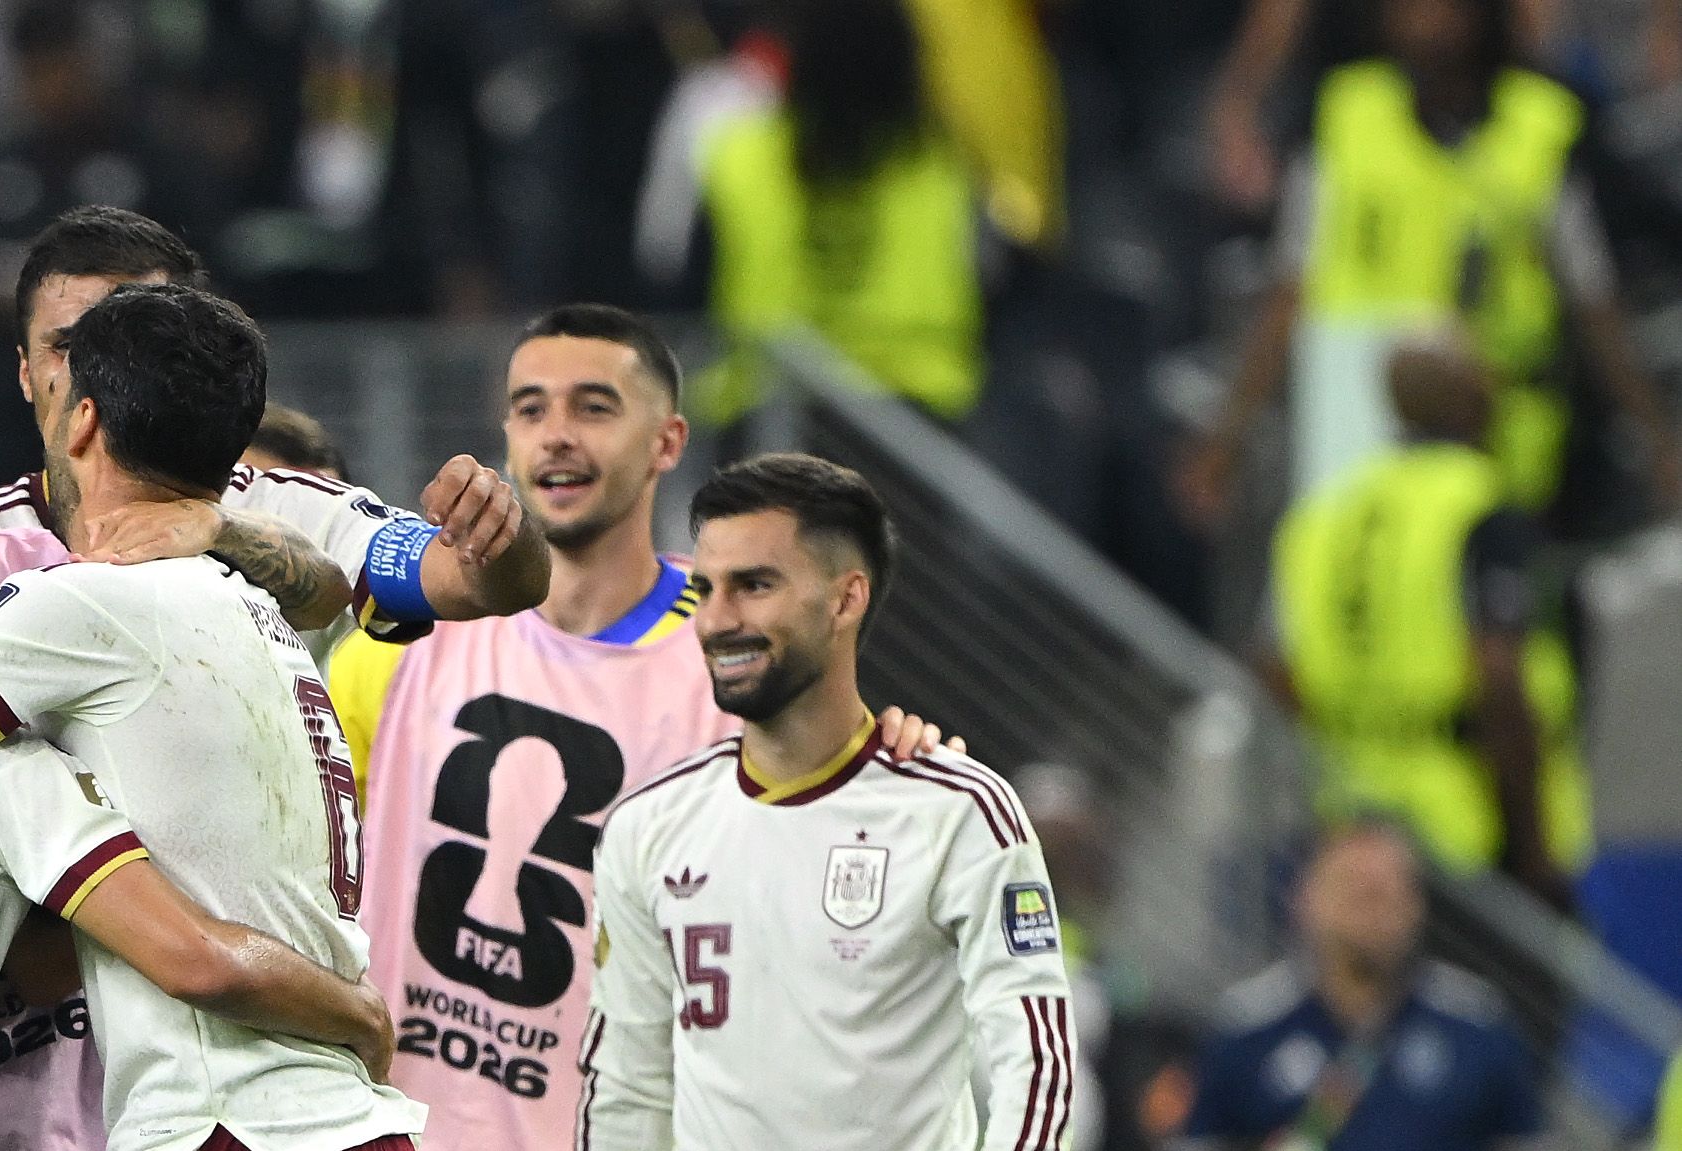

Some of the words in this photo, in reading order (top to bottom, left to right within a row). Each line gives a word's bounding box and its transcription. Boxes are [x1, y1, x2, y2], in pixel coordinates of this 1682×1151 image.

[380, 519, 414, 577] UNITE
[455, 926, 524, 981] FIFA
[397, 1017, 549, 1099] 2026
[496, 1018, 559, 1053] CUP
